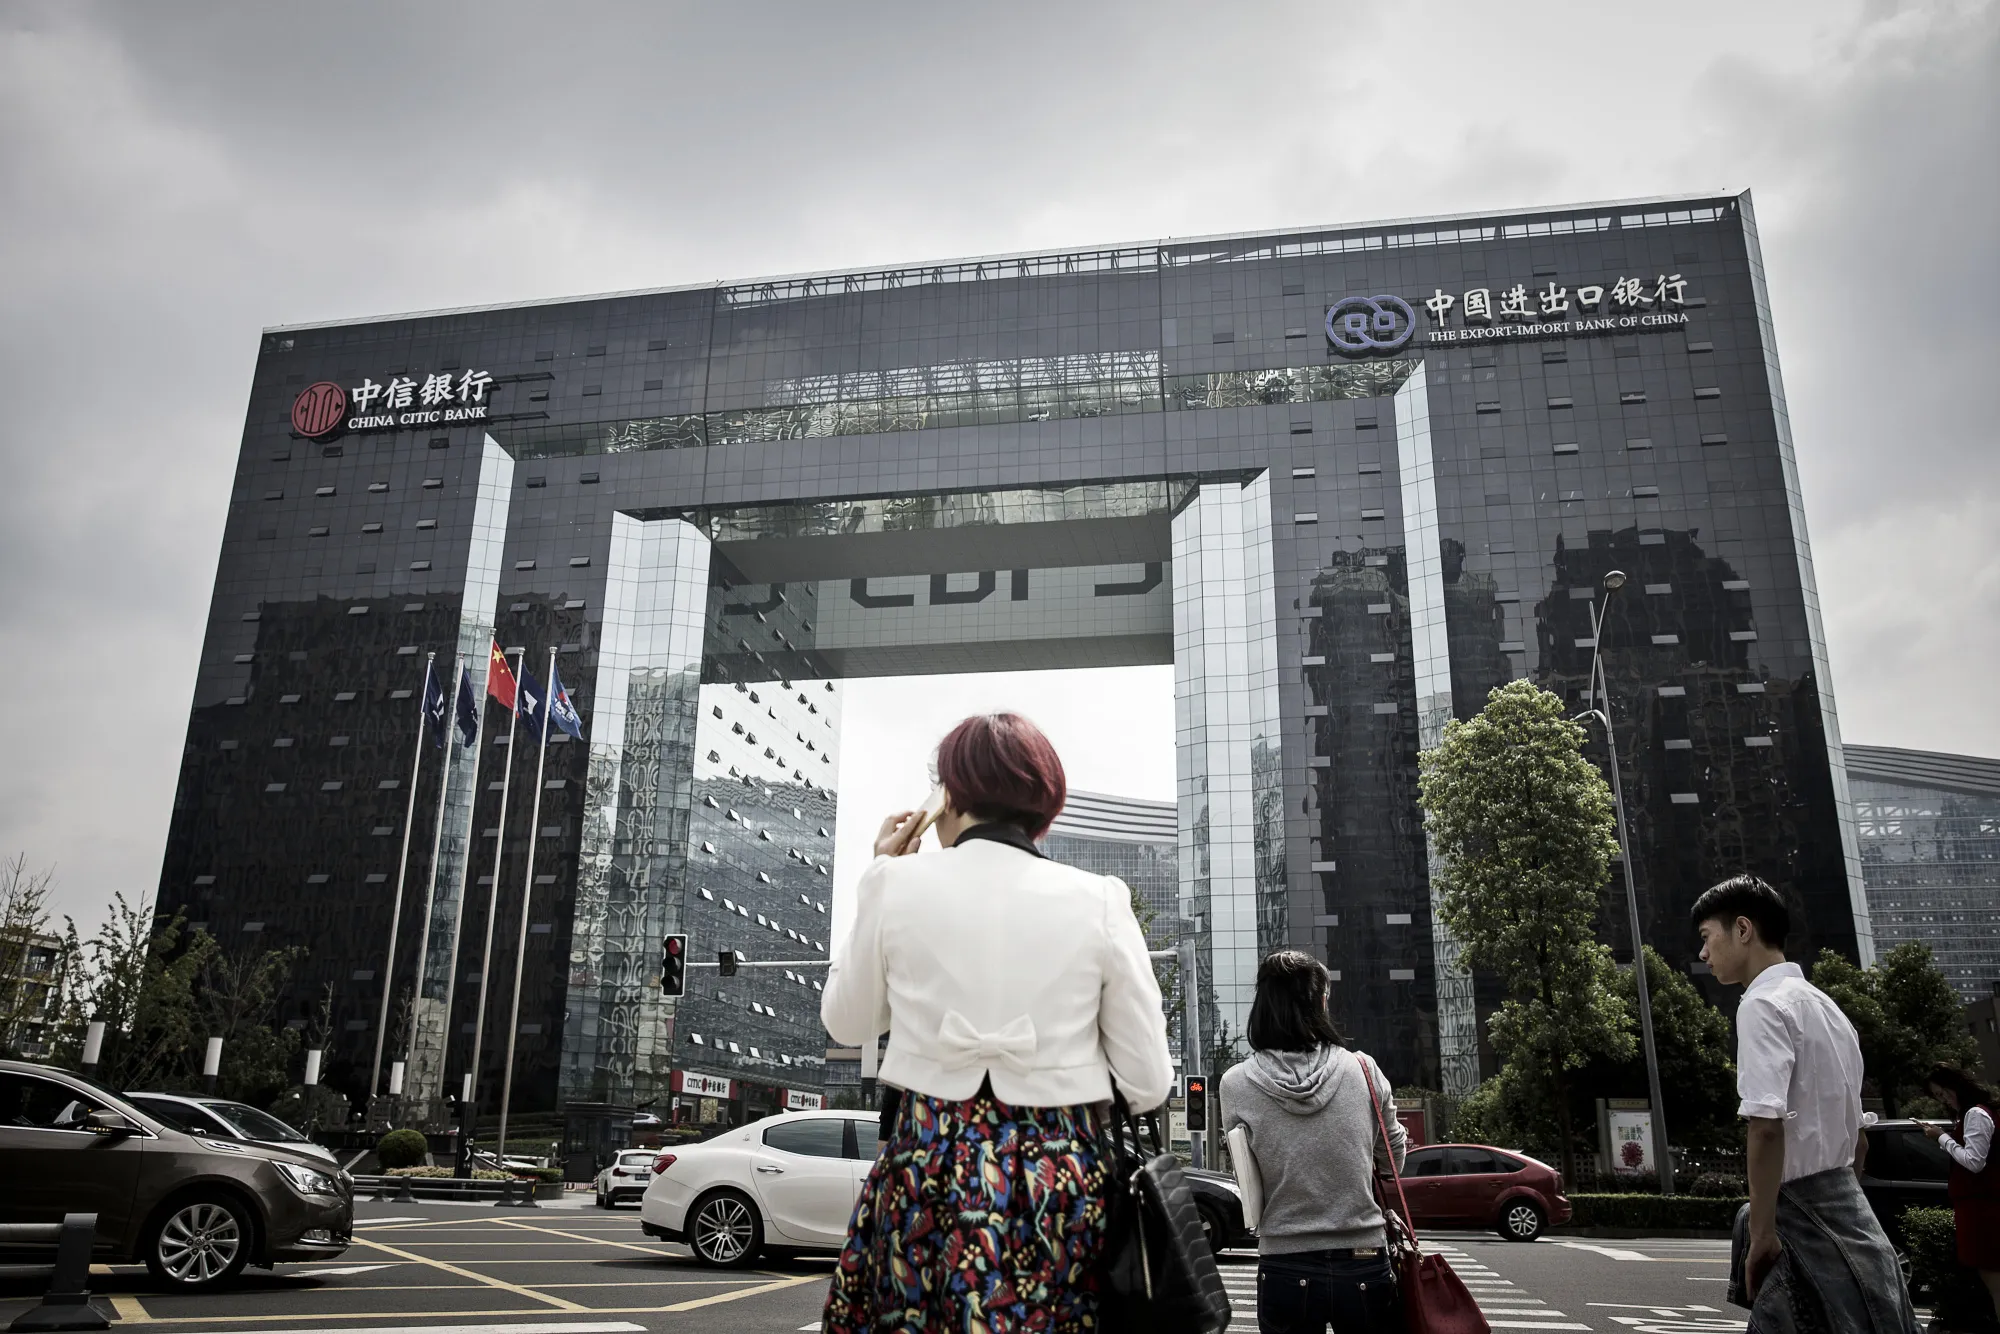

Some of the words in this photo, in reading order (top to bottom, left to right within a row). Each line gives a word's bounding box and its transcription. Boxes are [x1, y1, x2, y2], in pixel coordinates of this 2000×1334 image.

[1425, 273, 1688, 327] 中国进出口银行
[1428, 330, 1457, 342] THE
[1460, 321, 1571, 340] EXPORT-IMPORT
[1575, 318, 1616, 331] BANK
[1619, 316, 1638, 328] OF
[1641, 312, 1690, 326] CHINA
[352, 368, 493, 413] 中信银行
[348, 415, 395, 429] CHINA
[400, 410, 440, 424] CITIC
[444, 406, 488, 421] BANK
